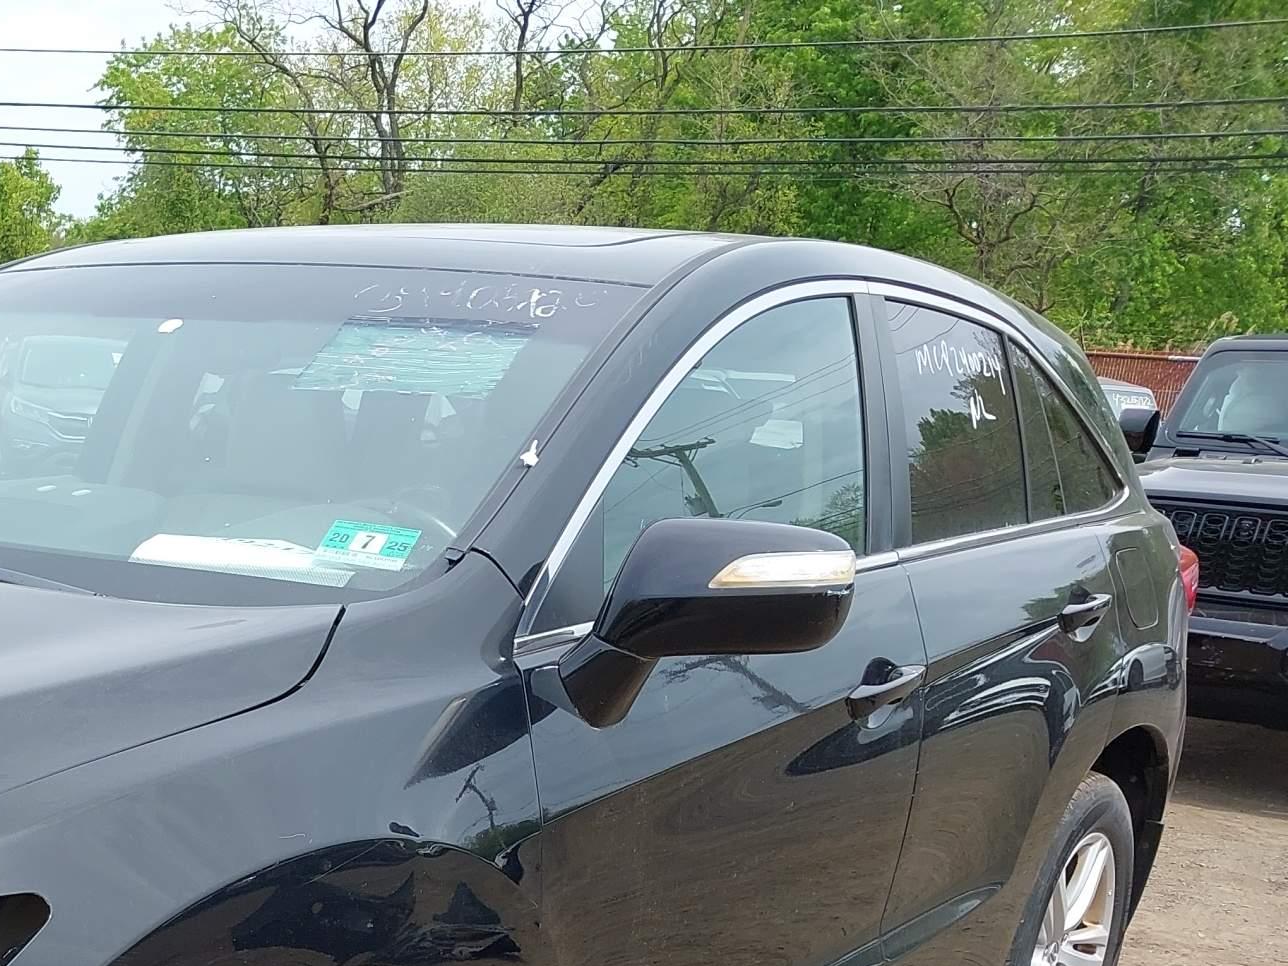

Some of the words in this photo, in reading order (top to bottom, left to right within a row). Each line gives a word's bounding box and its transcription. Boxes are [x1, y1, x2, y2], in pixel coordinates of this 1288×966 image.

[329, 531, 350, 544] 20
[360, 534, 376, 550] 7
[385, 540, 409, 552] 25
